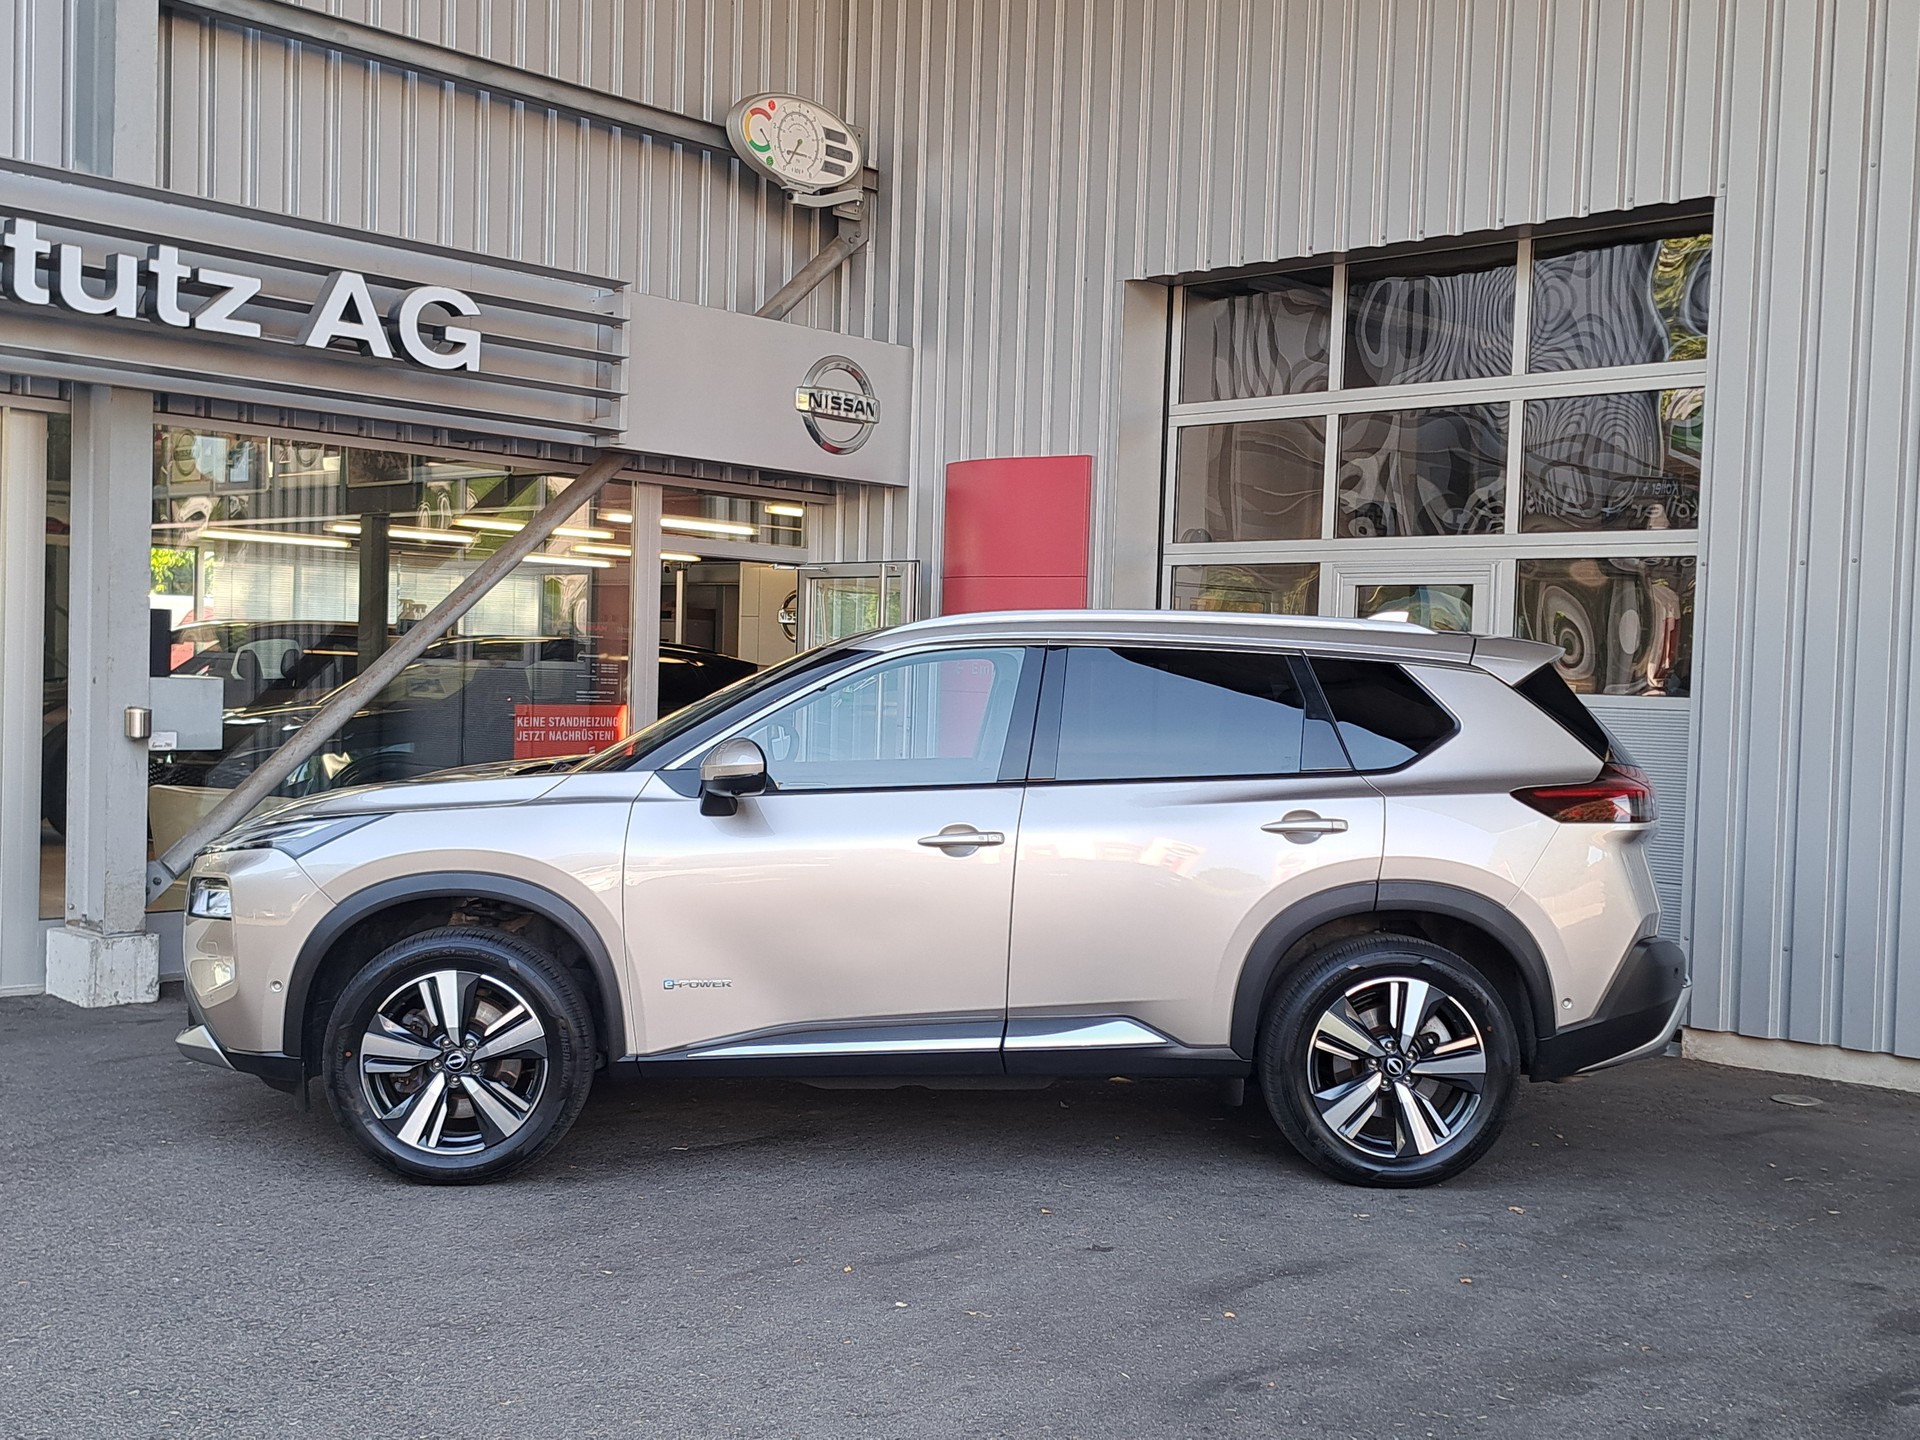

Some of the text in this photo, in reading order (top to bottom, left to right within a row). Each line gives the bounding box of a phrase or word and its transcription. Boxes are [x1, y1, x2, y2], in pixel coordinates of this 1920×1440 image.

[4, 218, 481, 371] tutz AG
[808, 392, 876, 417] NISSAN
[516, 716, 546, 727] KEINE
[516, 729, 615, 742] JETZT NACHRÜSTEN!
